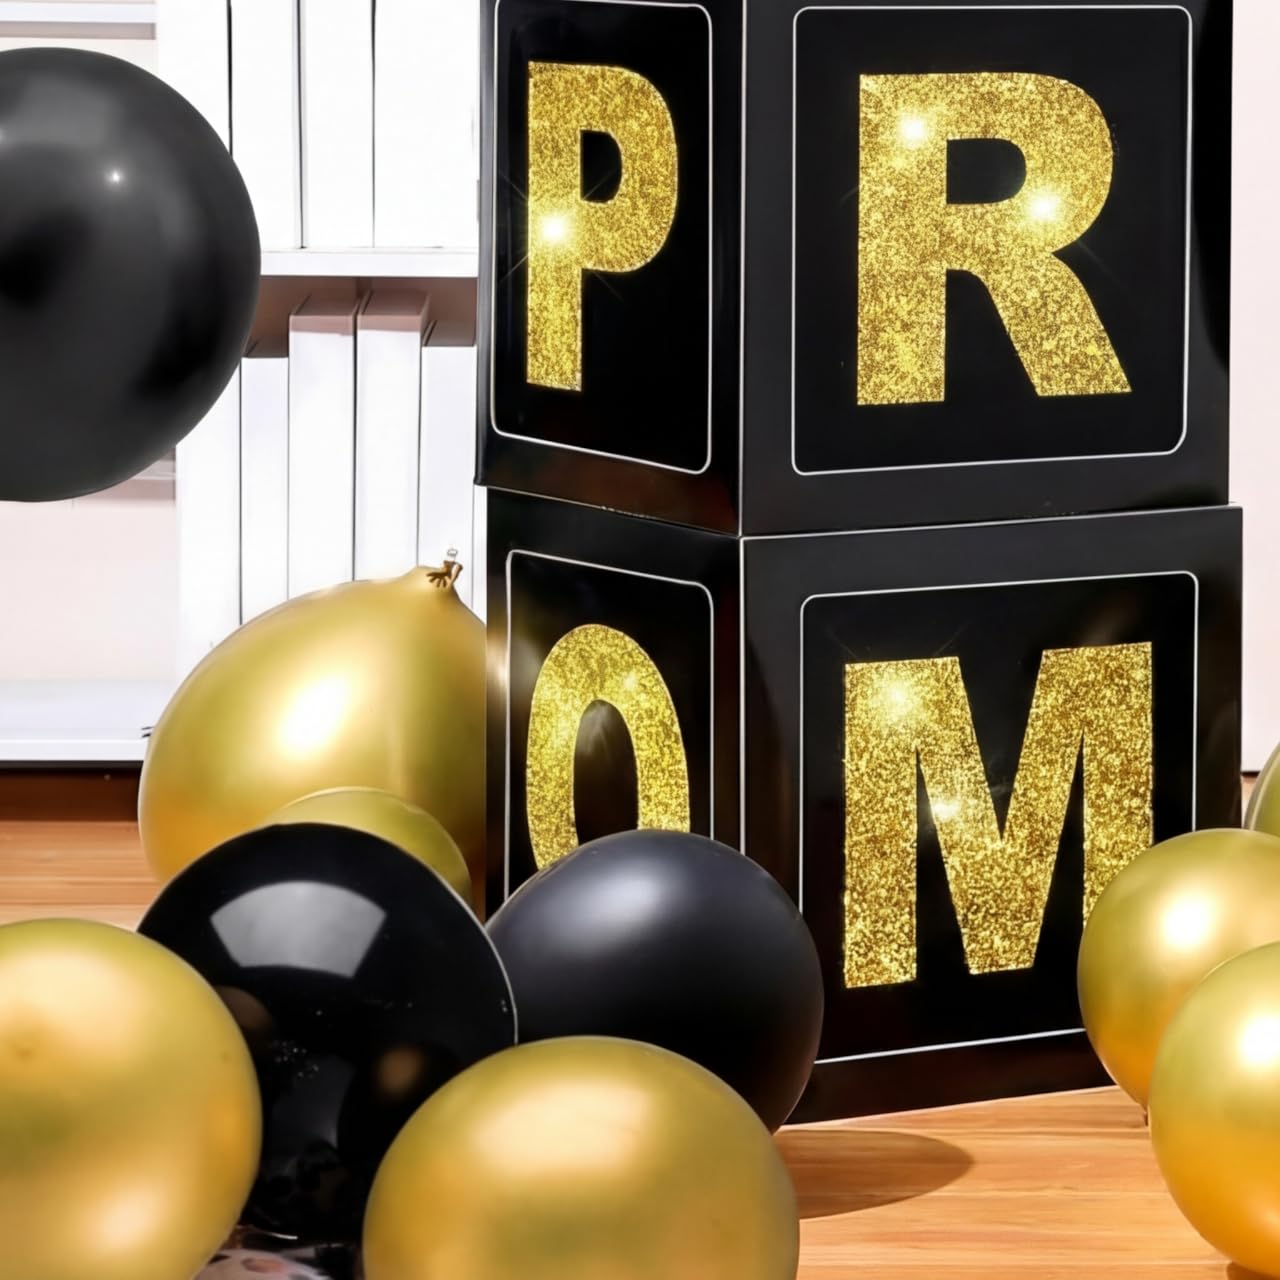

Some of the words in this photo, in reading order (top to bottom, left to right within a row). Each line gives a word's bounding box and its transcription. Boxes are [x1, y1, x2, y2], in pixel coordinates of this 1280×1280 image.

[526, 61, 679, 391] P
[857, 72, 1131, 406] R
[844, 642, 1154, 988] M
